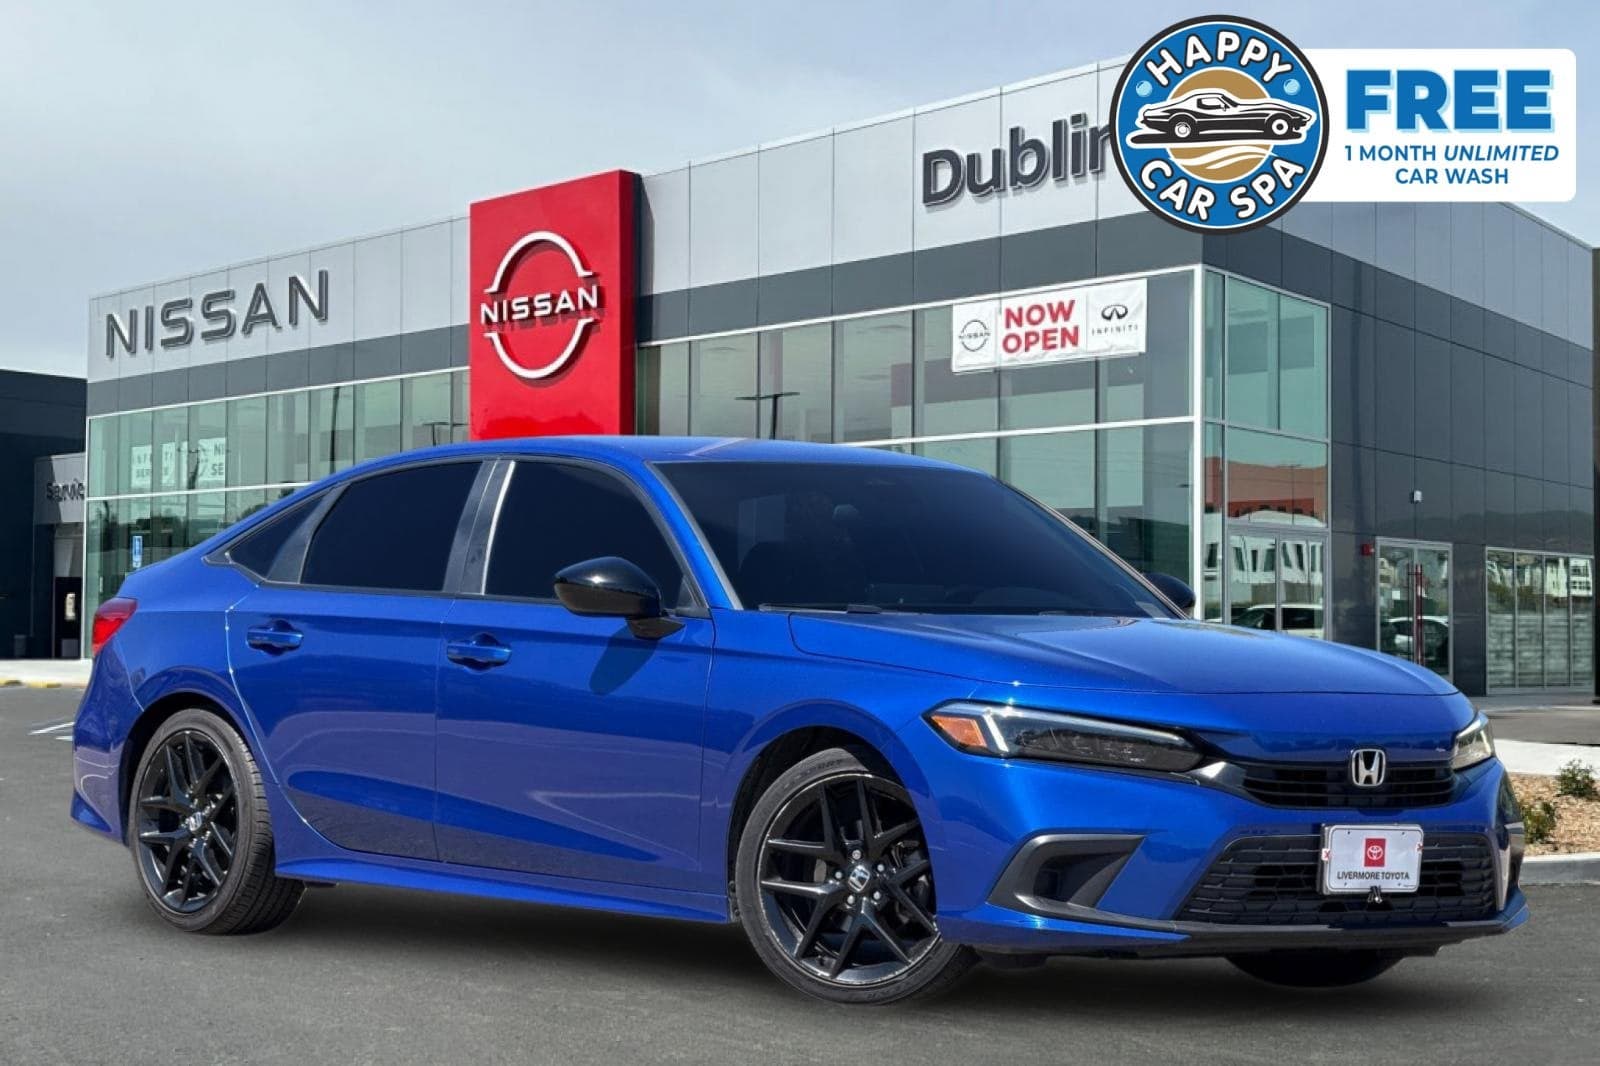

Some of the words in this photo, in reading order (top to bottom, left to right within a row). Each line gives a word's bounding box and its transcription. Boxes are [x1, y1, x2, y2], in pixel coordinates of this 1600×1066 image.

[106, 268, 330, 359] NISSAN
[480, 285, 597, 325] NISSAN
[1005, 300, 1075, 329] NOW
[1002, 326, 1079, 353] OPEN
[1337, 872, 1380, 880] LIVERMORE
[1381, 872, 1410, 880] TOYOTA
